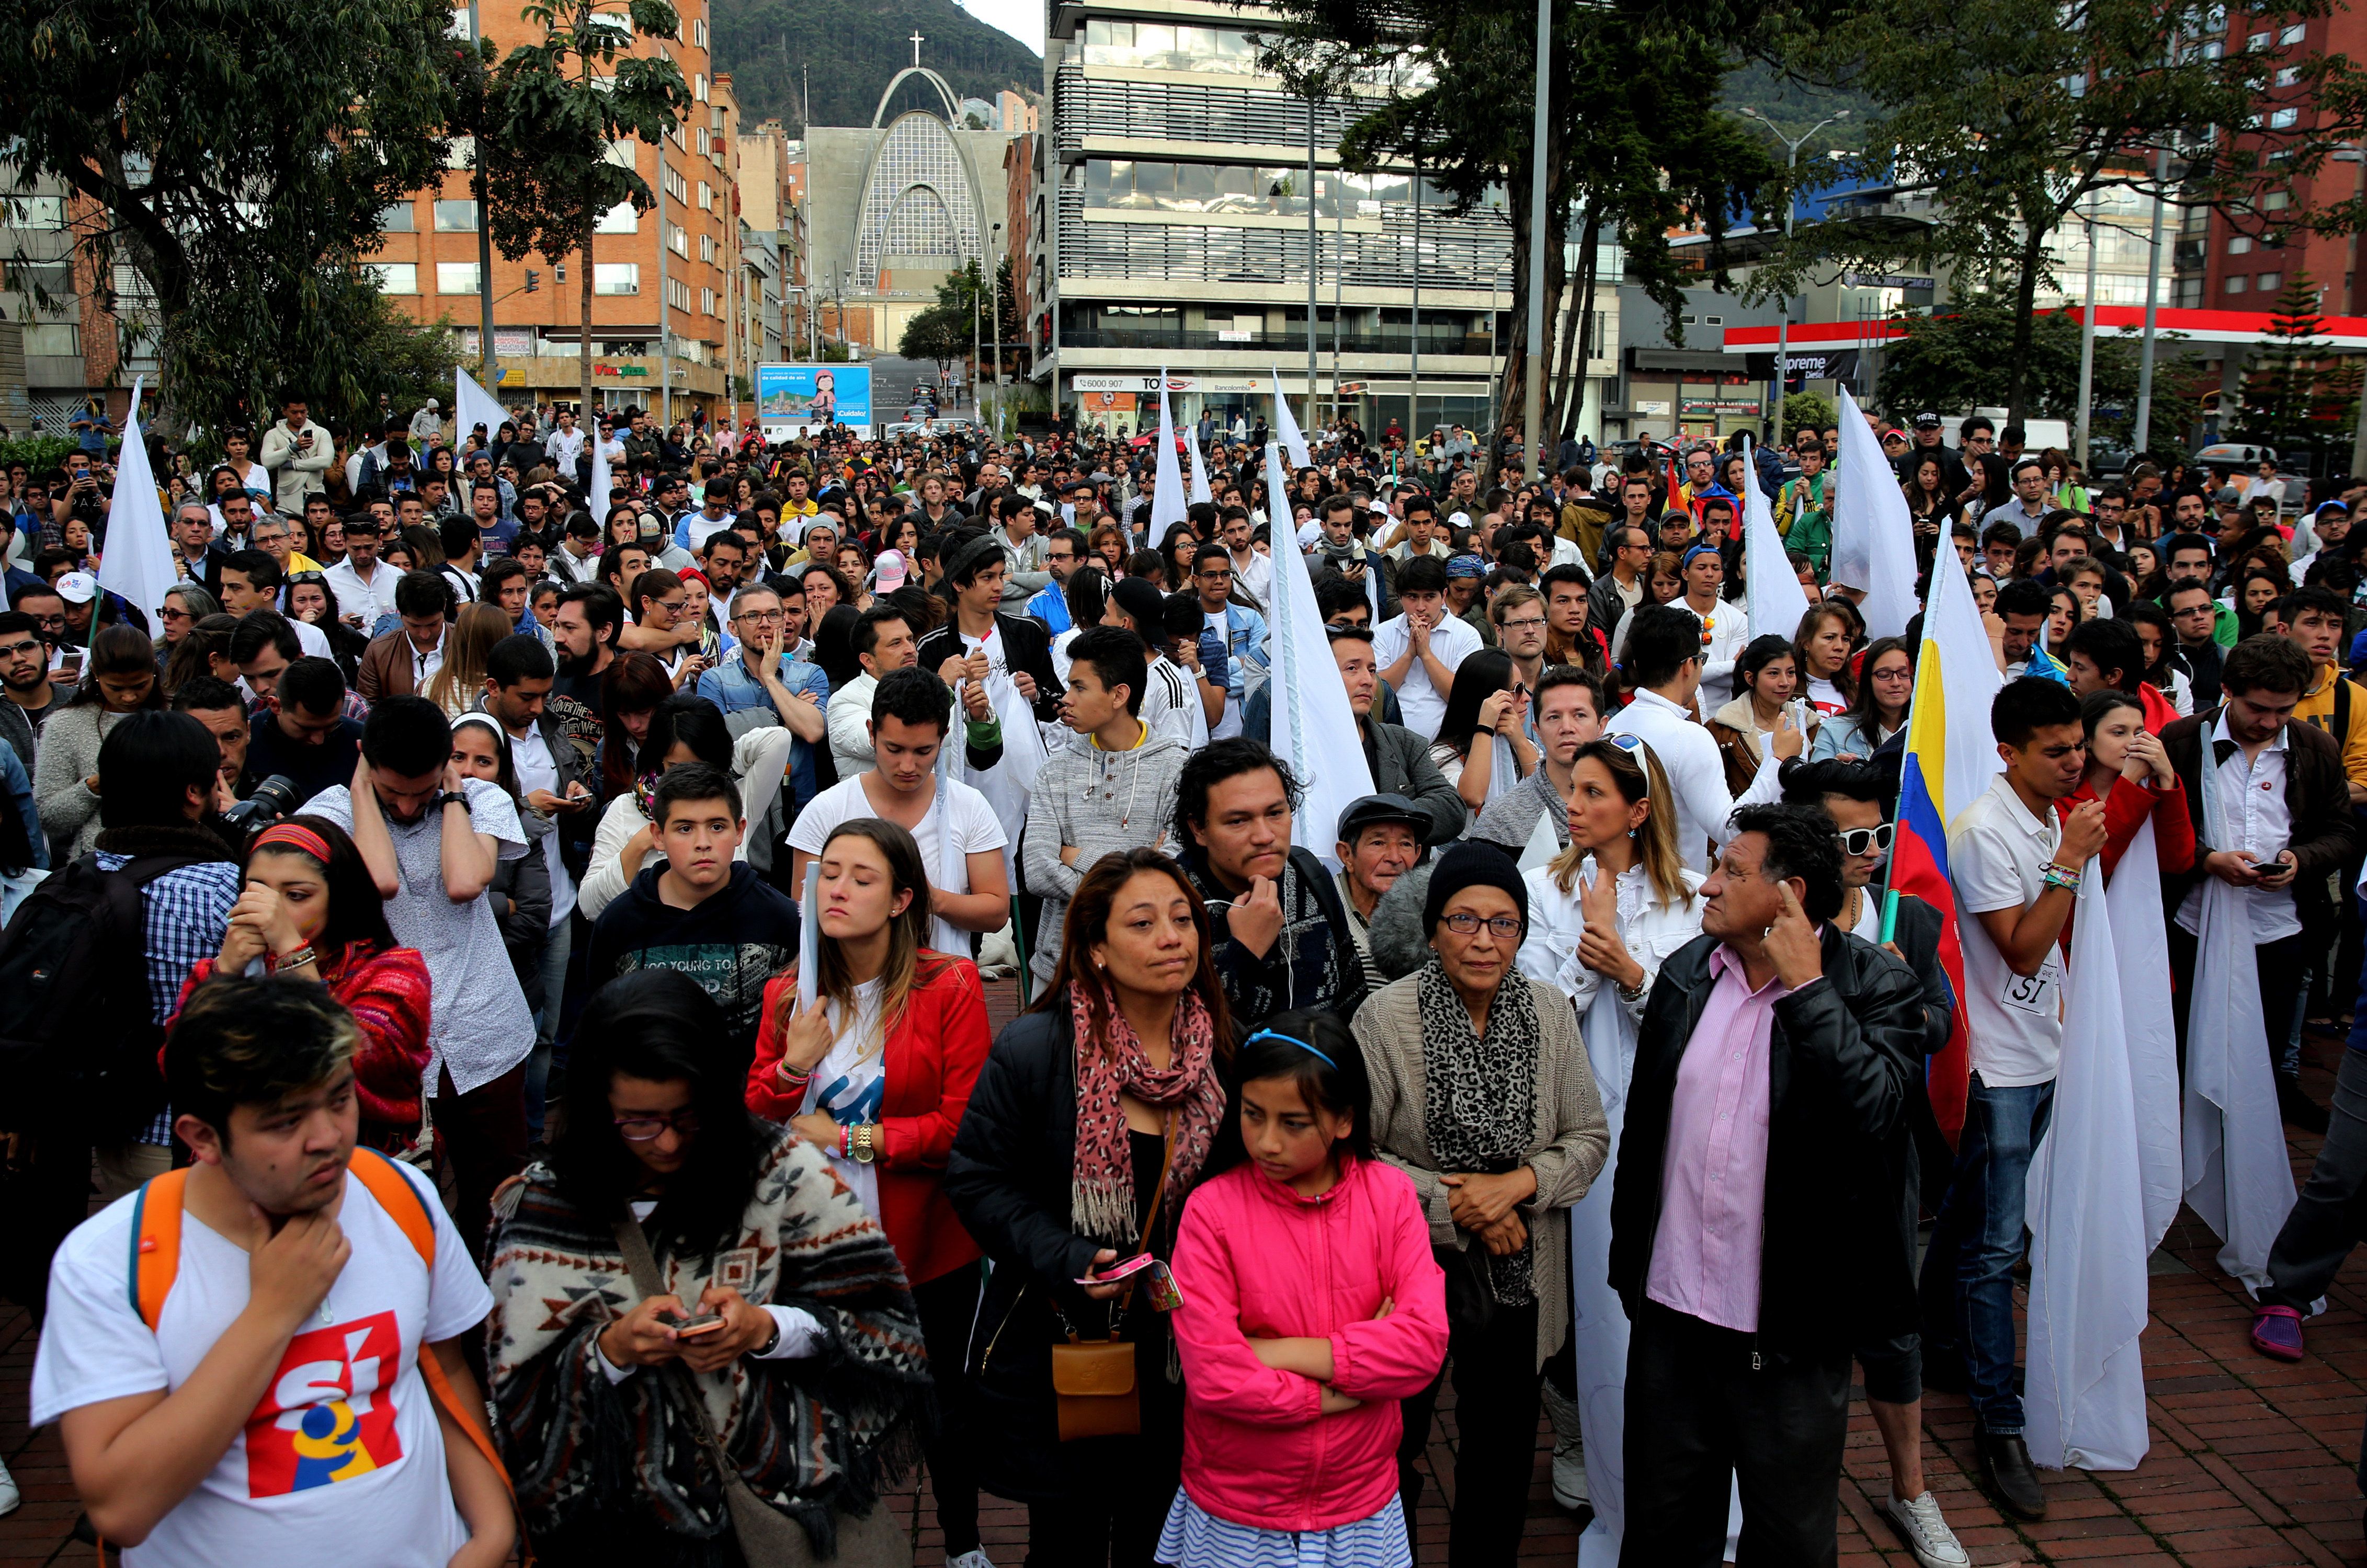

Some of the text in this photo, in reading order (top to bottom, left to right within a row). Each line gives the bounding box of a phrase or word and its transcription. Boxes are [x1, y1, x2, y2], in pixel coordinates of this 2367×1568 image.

[1805, 371, 1824, 379] Diesel
[1916, 413, 1937, 422] SWAT
[555, 699, 574, 714] OVER
[565, 720, 582, 735] THEY
[670, 959, 711, 972] YOUNG
[715, 959, 732, 970] TO
[2042, 970, 2053, 978] QUE
[2012, 976, 2047, 1004] SI
